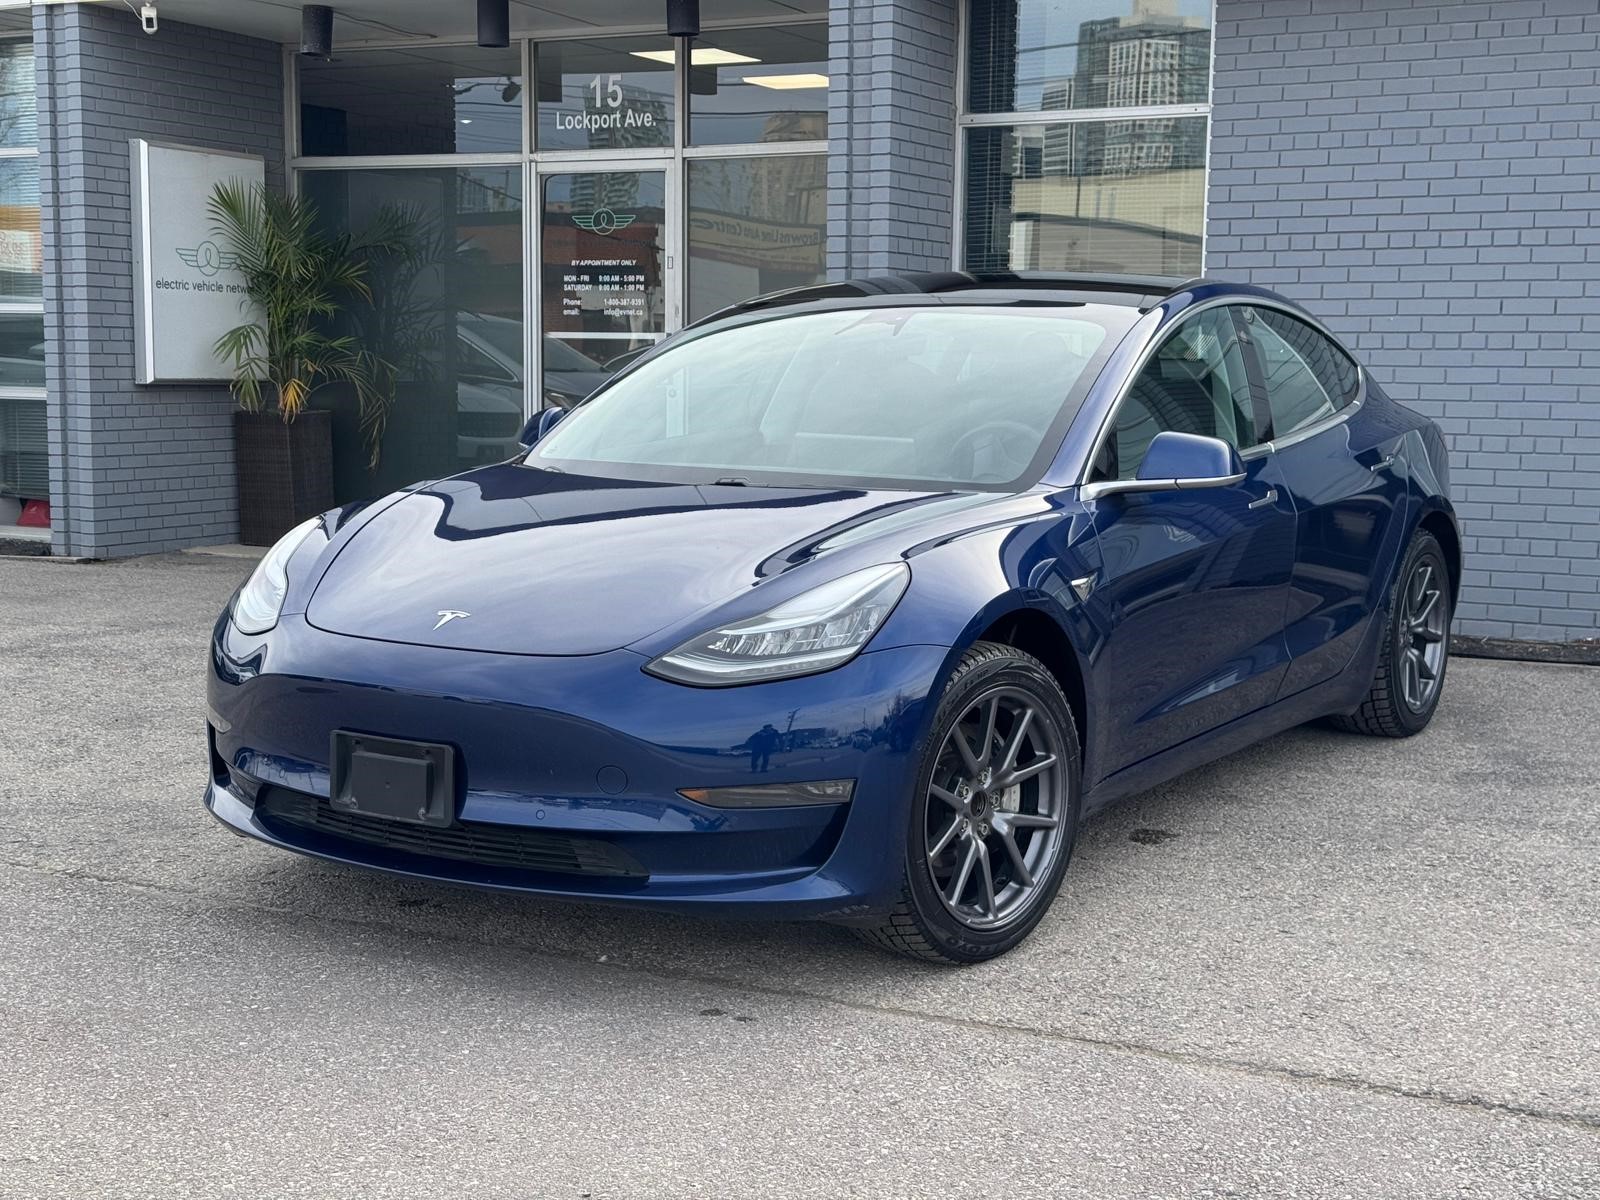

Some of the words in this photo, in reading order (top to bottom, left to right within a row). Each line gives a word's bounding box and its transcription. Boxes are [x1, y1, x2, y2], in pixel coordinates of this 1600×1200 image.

[590, 74, 623, 108] 15
[556, 110, 621, 133] Lockport
[624, 108, 656, 128] Ave.
[155, 278, 190, 291] electric
[192, 280, 224, 293] vehicle
[226, 284, 250, 294] netw
